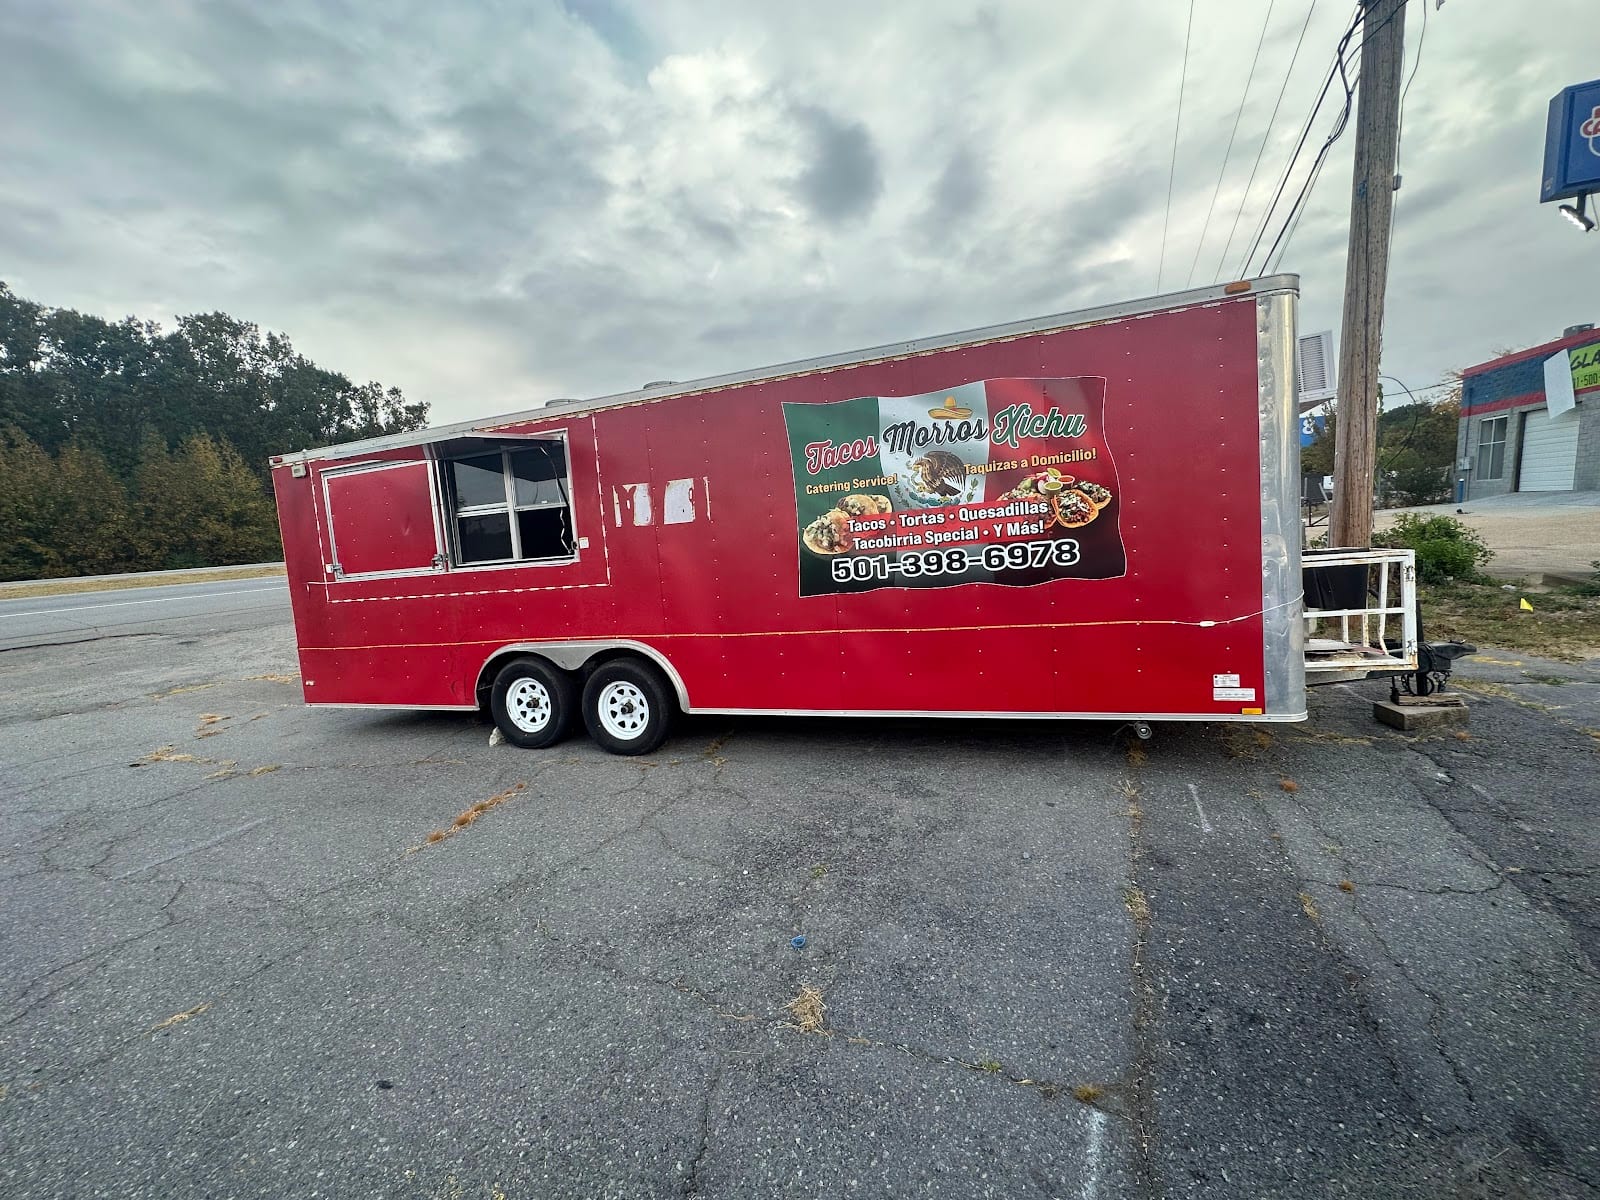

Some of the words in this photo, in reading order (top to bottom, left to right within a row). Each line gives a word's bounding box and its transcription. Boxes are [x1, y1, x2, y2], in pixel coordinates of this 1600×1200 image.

[805, 436, 879, 475] Tacos
[882, 418, 989, 457] Morros
[991, 402, 1087, 448] Xichu
[963, 460, 1018, 475] Taquizas
[1020, 458, 1029, 468] a
[1031, 447, 1097, 467] Domicilio!
[806, 480, 851, 496] Catering
[852, 473, 899, 490] Service!
[847, 518, 886, 533] Tacos
[898, 512, 945, 528] Tortas
[958, 501, 1048, 522] Quesadillas
[852, 531, 922, 550] Tacobirria
[925, 526, 979, 546] Special
[992, 523, 1003, 538] Y
[1006, 519, 1044, 537] Más!
[831, 538, 1080, 583] 501-398-6978
